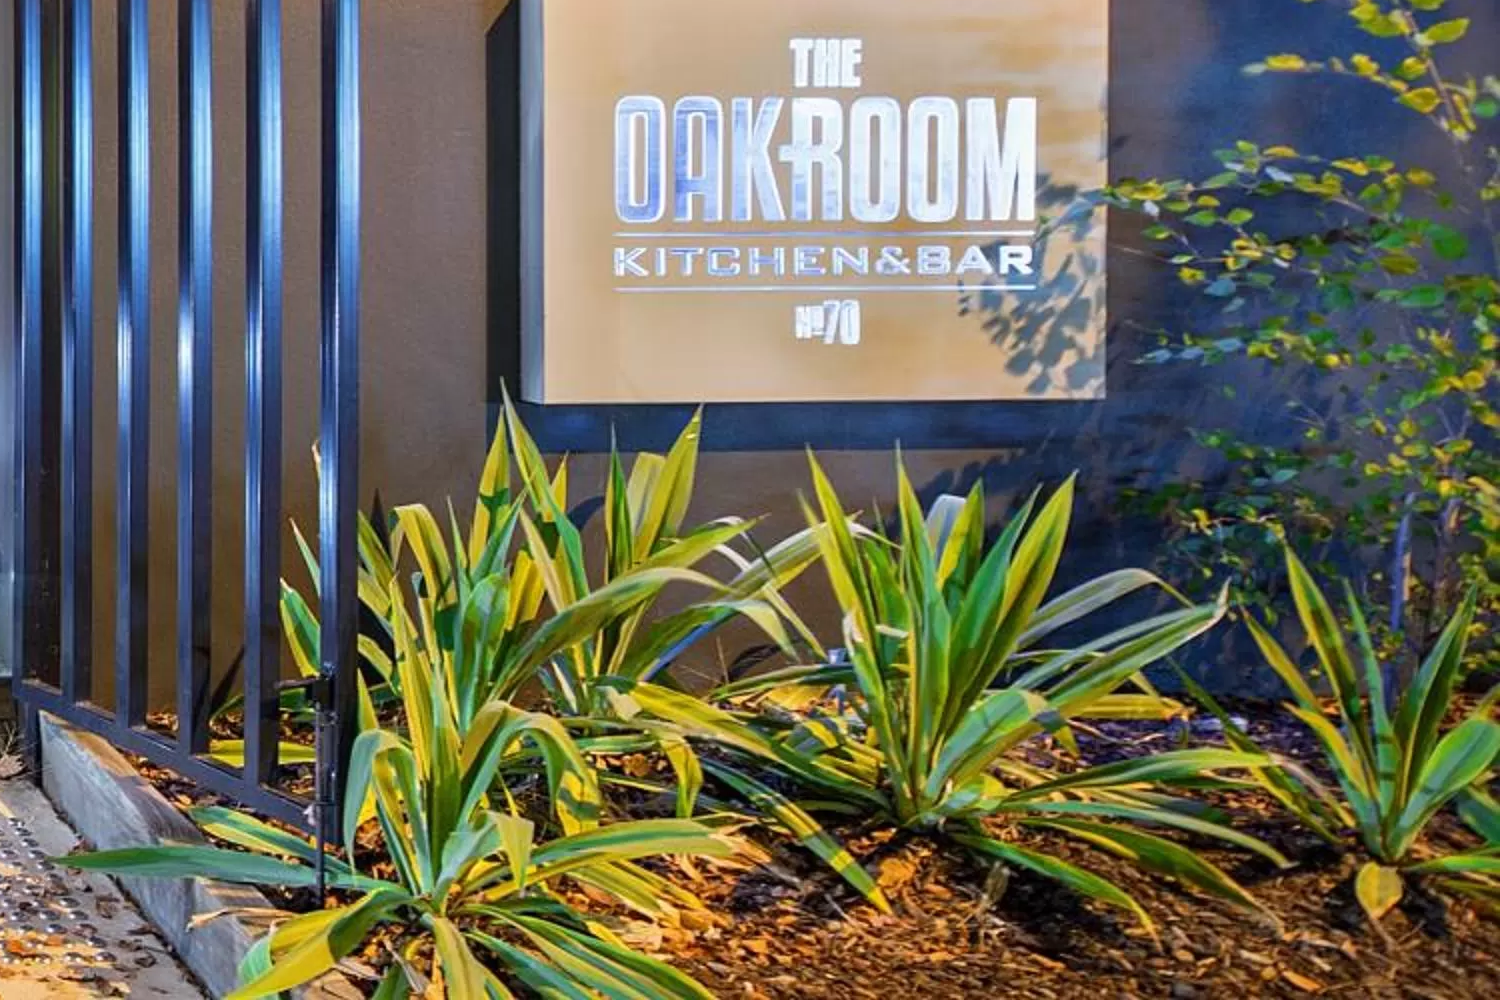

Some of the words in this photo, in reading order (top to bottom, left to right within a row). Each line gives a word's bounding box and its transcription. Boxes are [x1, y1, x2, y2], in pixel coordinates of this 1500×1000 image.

[790, 38, 862, 88] THE
[614, 95, 1037, 223] OAKROOM
[613, 245, 1033, 277] KITCHEN&BAR
